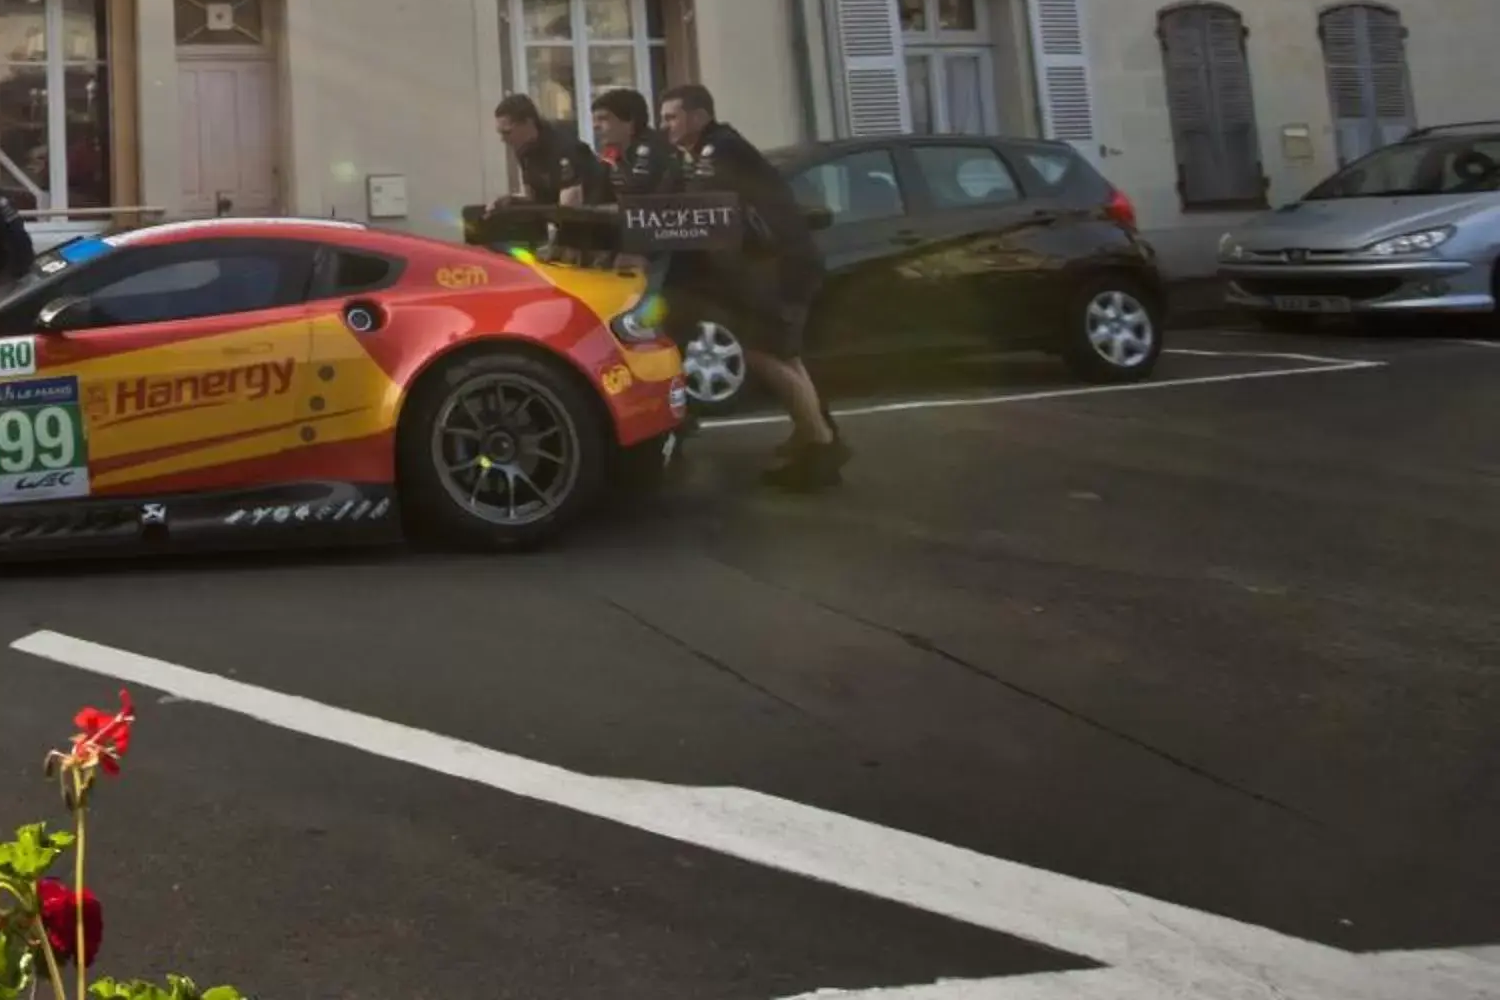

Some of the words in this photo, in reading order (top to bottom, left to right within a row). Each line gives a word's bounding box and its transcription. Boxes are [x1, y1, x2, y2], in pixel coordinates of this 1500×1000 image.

[626, 207, 733, 228] HACKETT
[654, 228, 708, 240] LONDON
[436, 266, 489, 289] ecm
[115, 357, 294, 414] Hanergy
[15, 471, 75, 490] WEC
